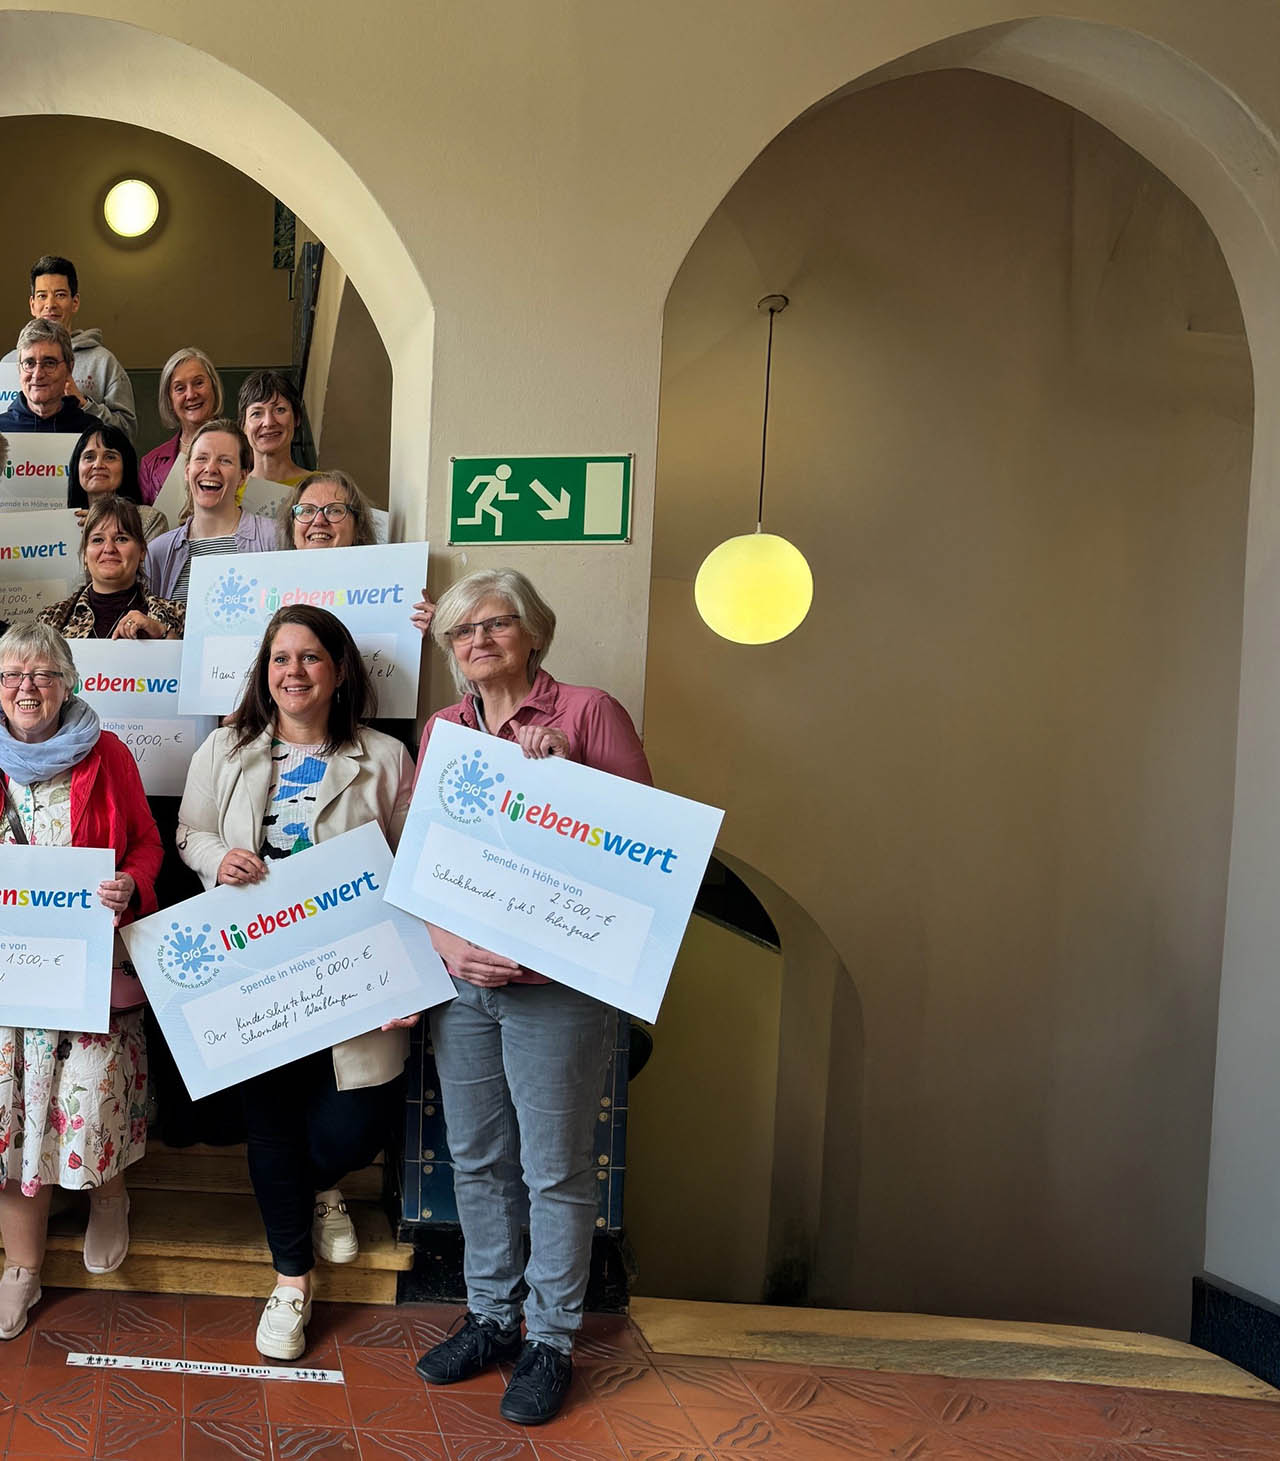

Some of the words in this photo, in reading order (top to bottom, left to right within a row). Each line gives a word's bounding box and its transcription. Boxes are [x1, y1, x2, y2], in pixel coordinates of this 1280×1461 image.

[127, 723, 144, 731] von
[481, 849, 518, 871] Spende
[519, 863, 530, 877] in
[531, 869, 560, 889] Höhe
[562, 883, 583, 897] von
[8, 942, 27, 950] von
[362, 945, 372, 960] €
[54, 954, 64, 966] €
[240, 974, 277, 995] Spende
[277, 968, 288, 980] in
[289, 957, 317, 975] Höhe
[317, 950, 337, 962] von
[204, 1030, 227, 1046] Der
[141, 1359, 171, 1369] Bitte
[174, 1361, 227, 1373] Abstand
[230, 1365, 271, 1375] halten
